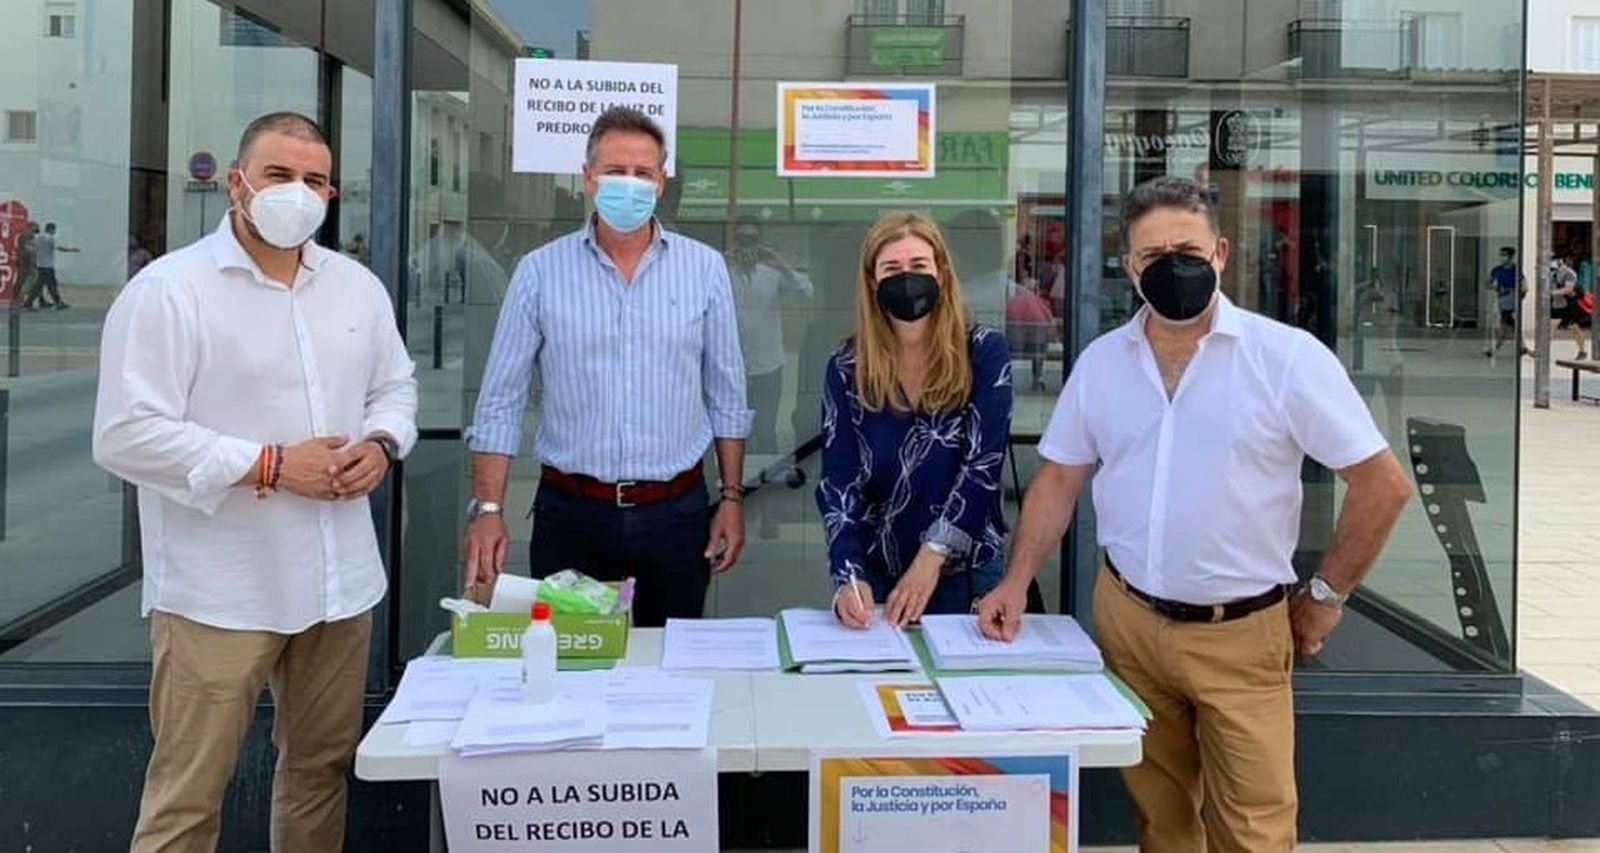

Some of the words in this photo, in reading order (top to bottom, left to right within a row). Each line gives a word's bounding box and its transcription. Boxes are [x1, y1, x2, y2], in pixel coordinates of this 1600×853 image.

[529, 78, 550, 90] NO
[554, 79, 564, 91] A
[567, 79, 583, 91] LA
[586, 80, 637, 93] SUBIDA
[640, 82, 665, 94] DEL
[527, 100, 576, 113] RECIBO
[579, 102, 597, 113] DE
[648, 104, 665, 116] DE
[1375, 169, 1442, 186] UNITED
[1446, 171, 1519, 188] COLORS
[481, 787, 519, 806] NO
[526, 787, 544, 804] A
[551, 785, 580, 804] LA
[588, 782, 680, 802] SUBIDA
[852, 785, 873, 798] Por
[876, 785, 888, 798] la
[891, 783, 980, 799] Constitución,
[852, 799, 864, 812] la
[866, 799, 918, 812] Justicia
[920, 802, 928, 814] y
[931, 801, 953, 814] por
[956, 799, 1007, 814] España
[475, 824, 519, 840] DEL
[526, 821, 614, 840] RECIBO
[622, 820, 653, 839] DE
[661, 820, 690, 839] LA
